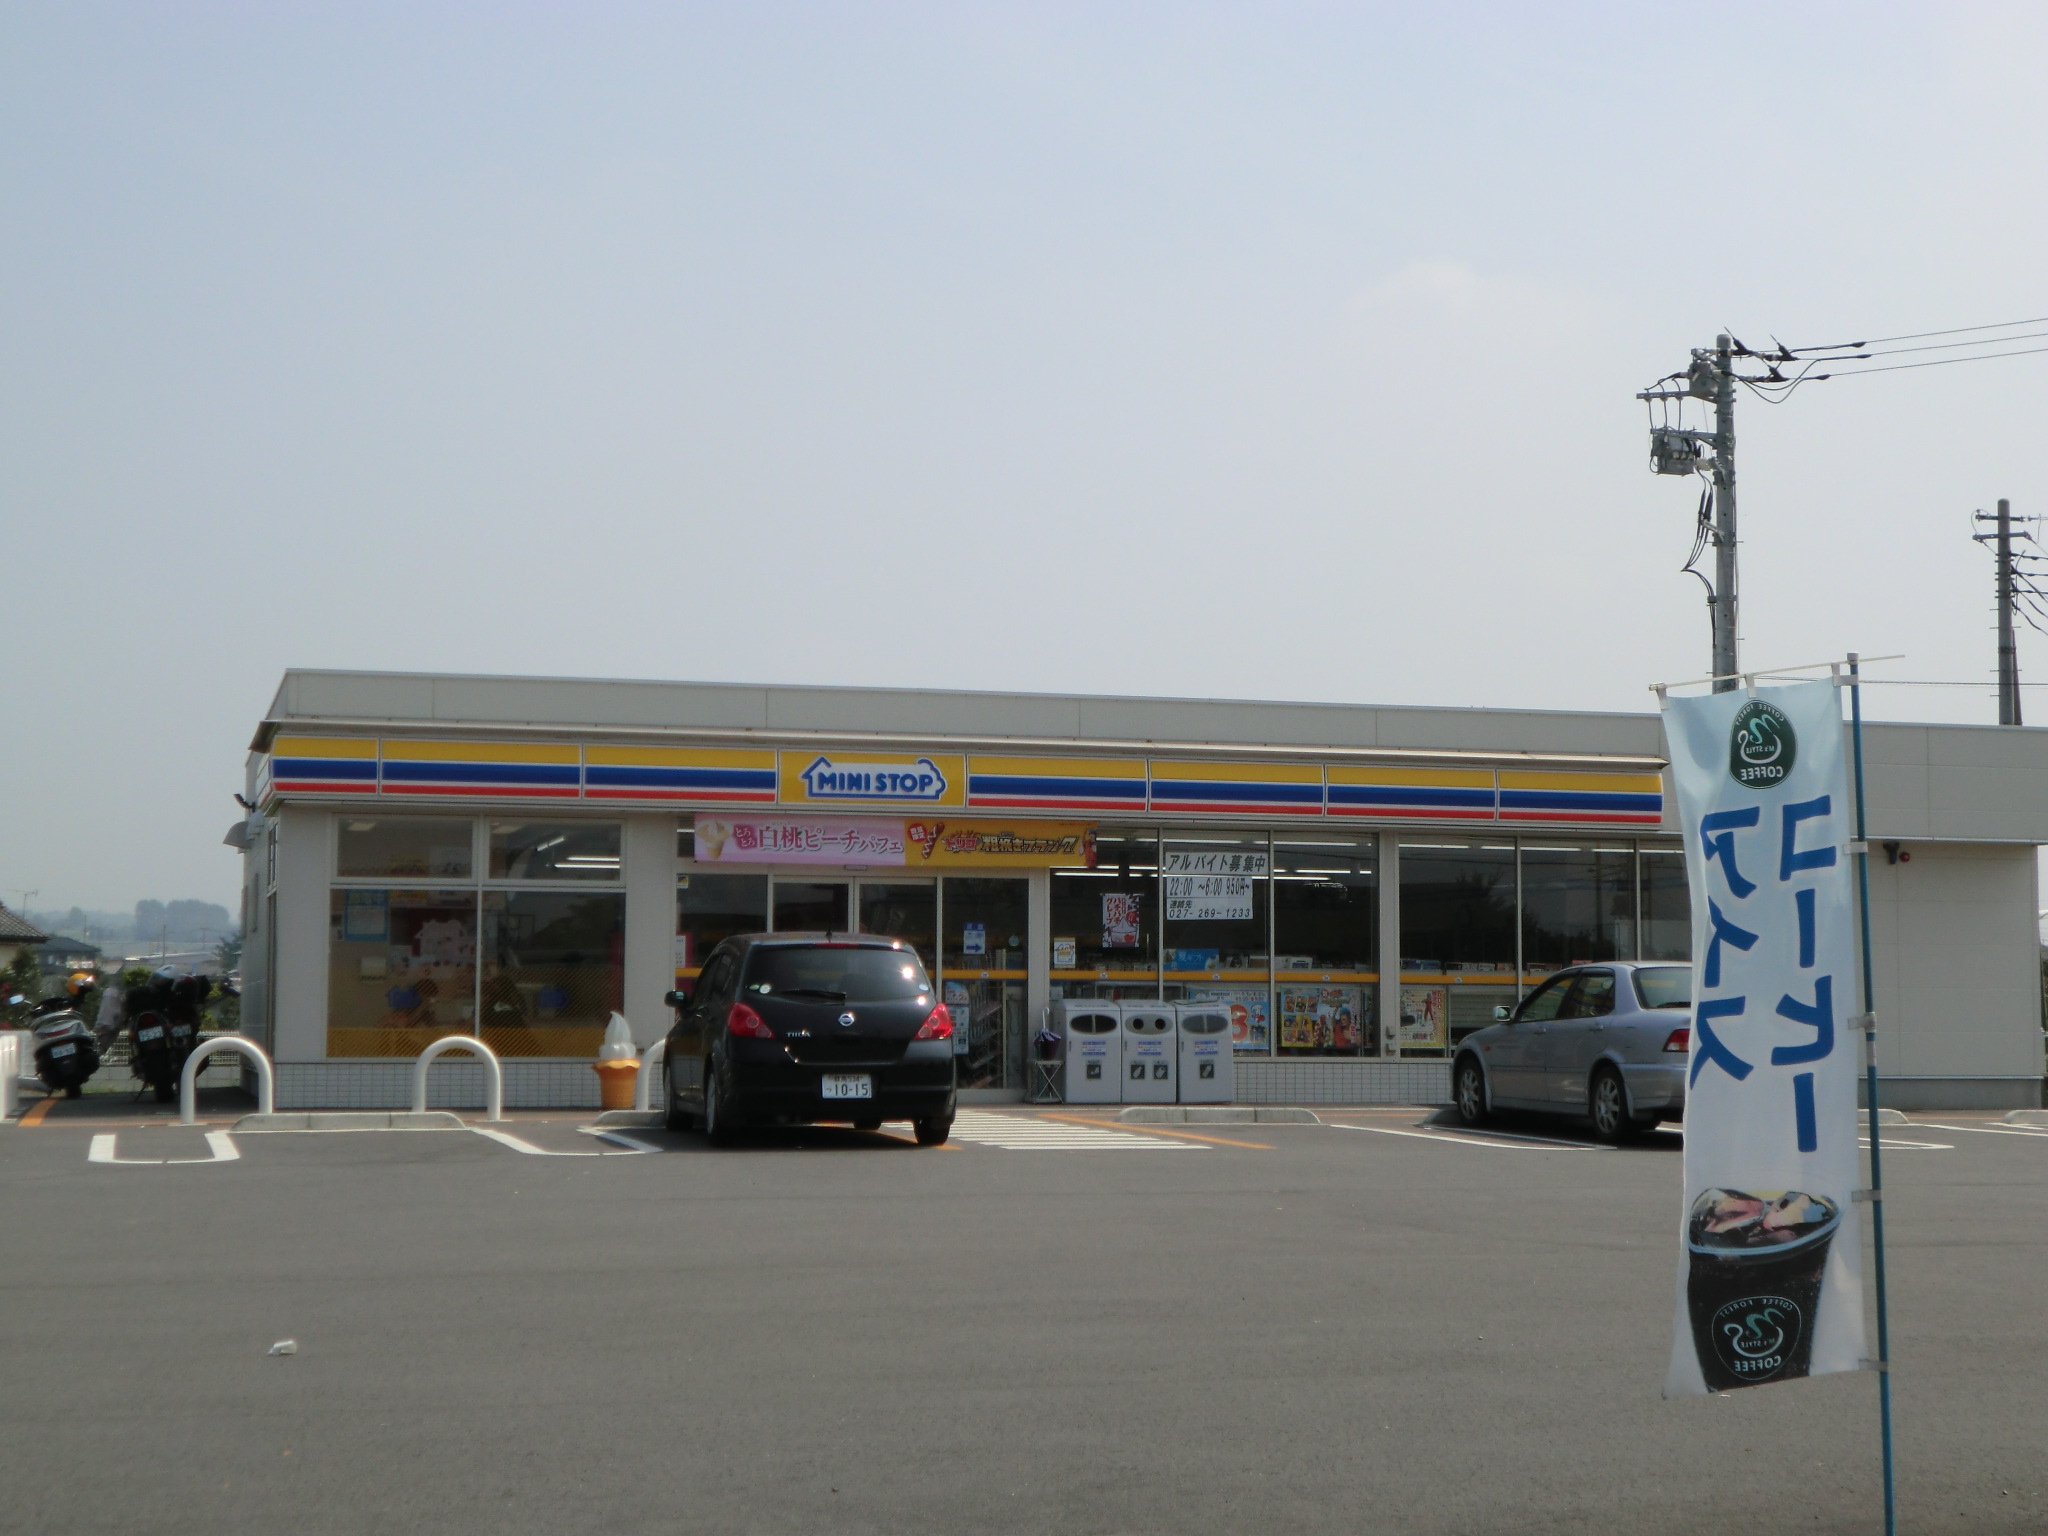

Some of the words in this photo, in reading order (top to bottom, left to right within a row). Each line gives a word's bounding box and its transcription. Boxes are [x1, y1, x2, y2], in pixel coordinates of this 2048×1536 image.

[818, 772, 870, 791] MINI
[876, 772, 934, 792] STOP
[1168, 854, 1266, 872] アルバイト募集中
[1170, 877, 1193, 896] 22:00
[1169, 900, 1193, 909] 連絡先
[835, 1083, 869, 1096] 10-15
